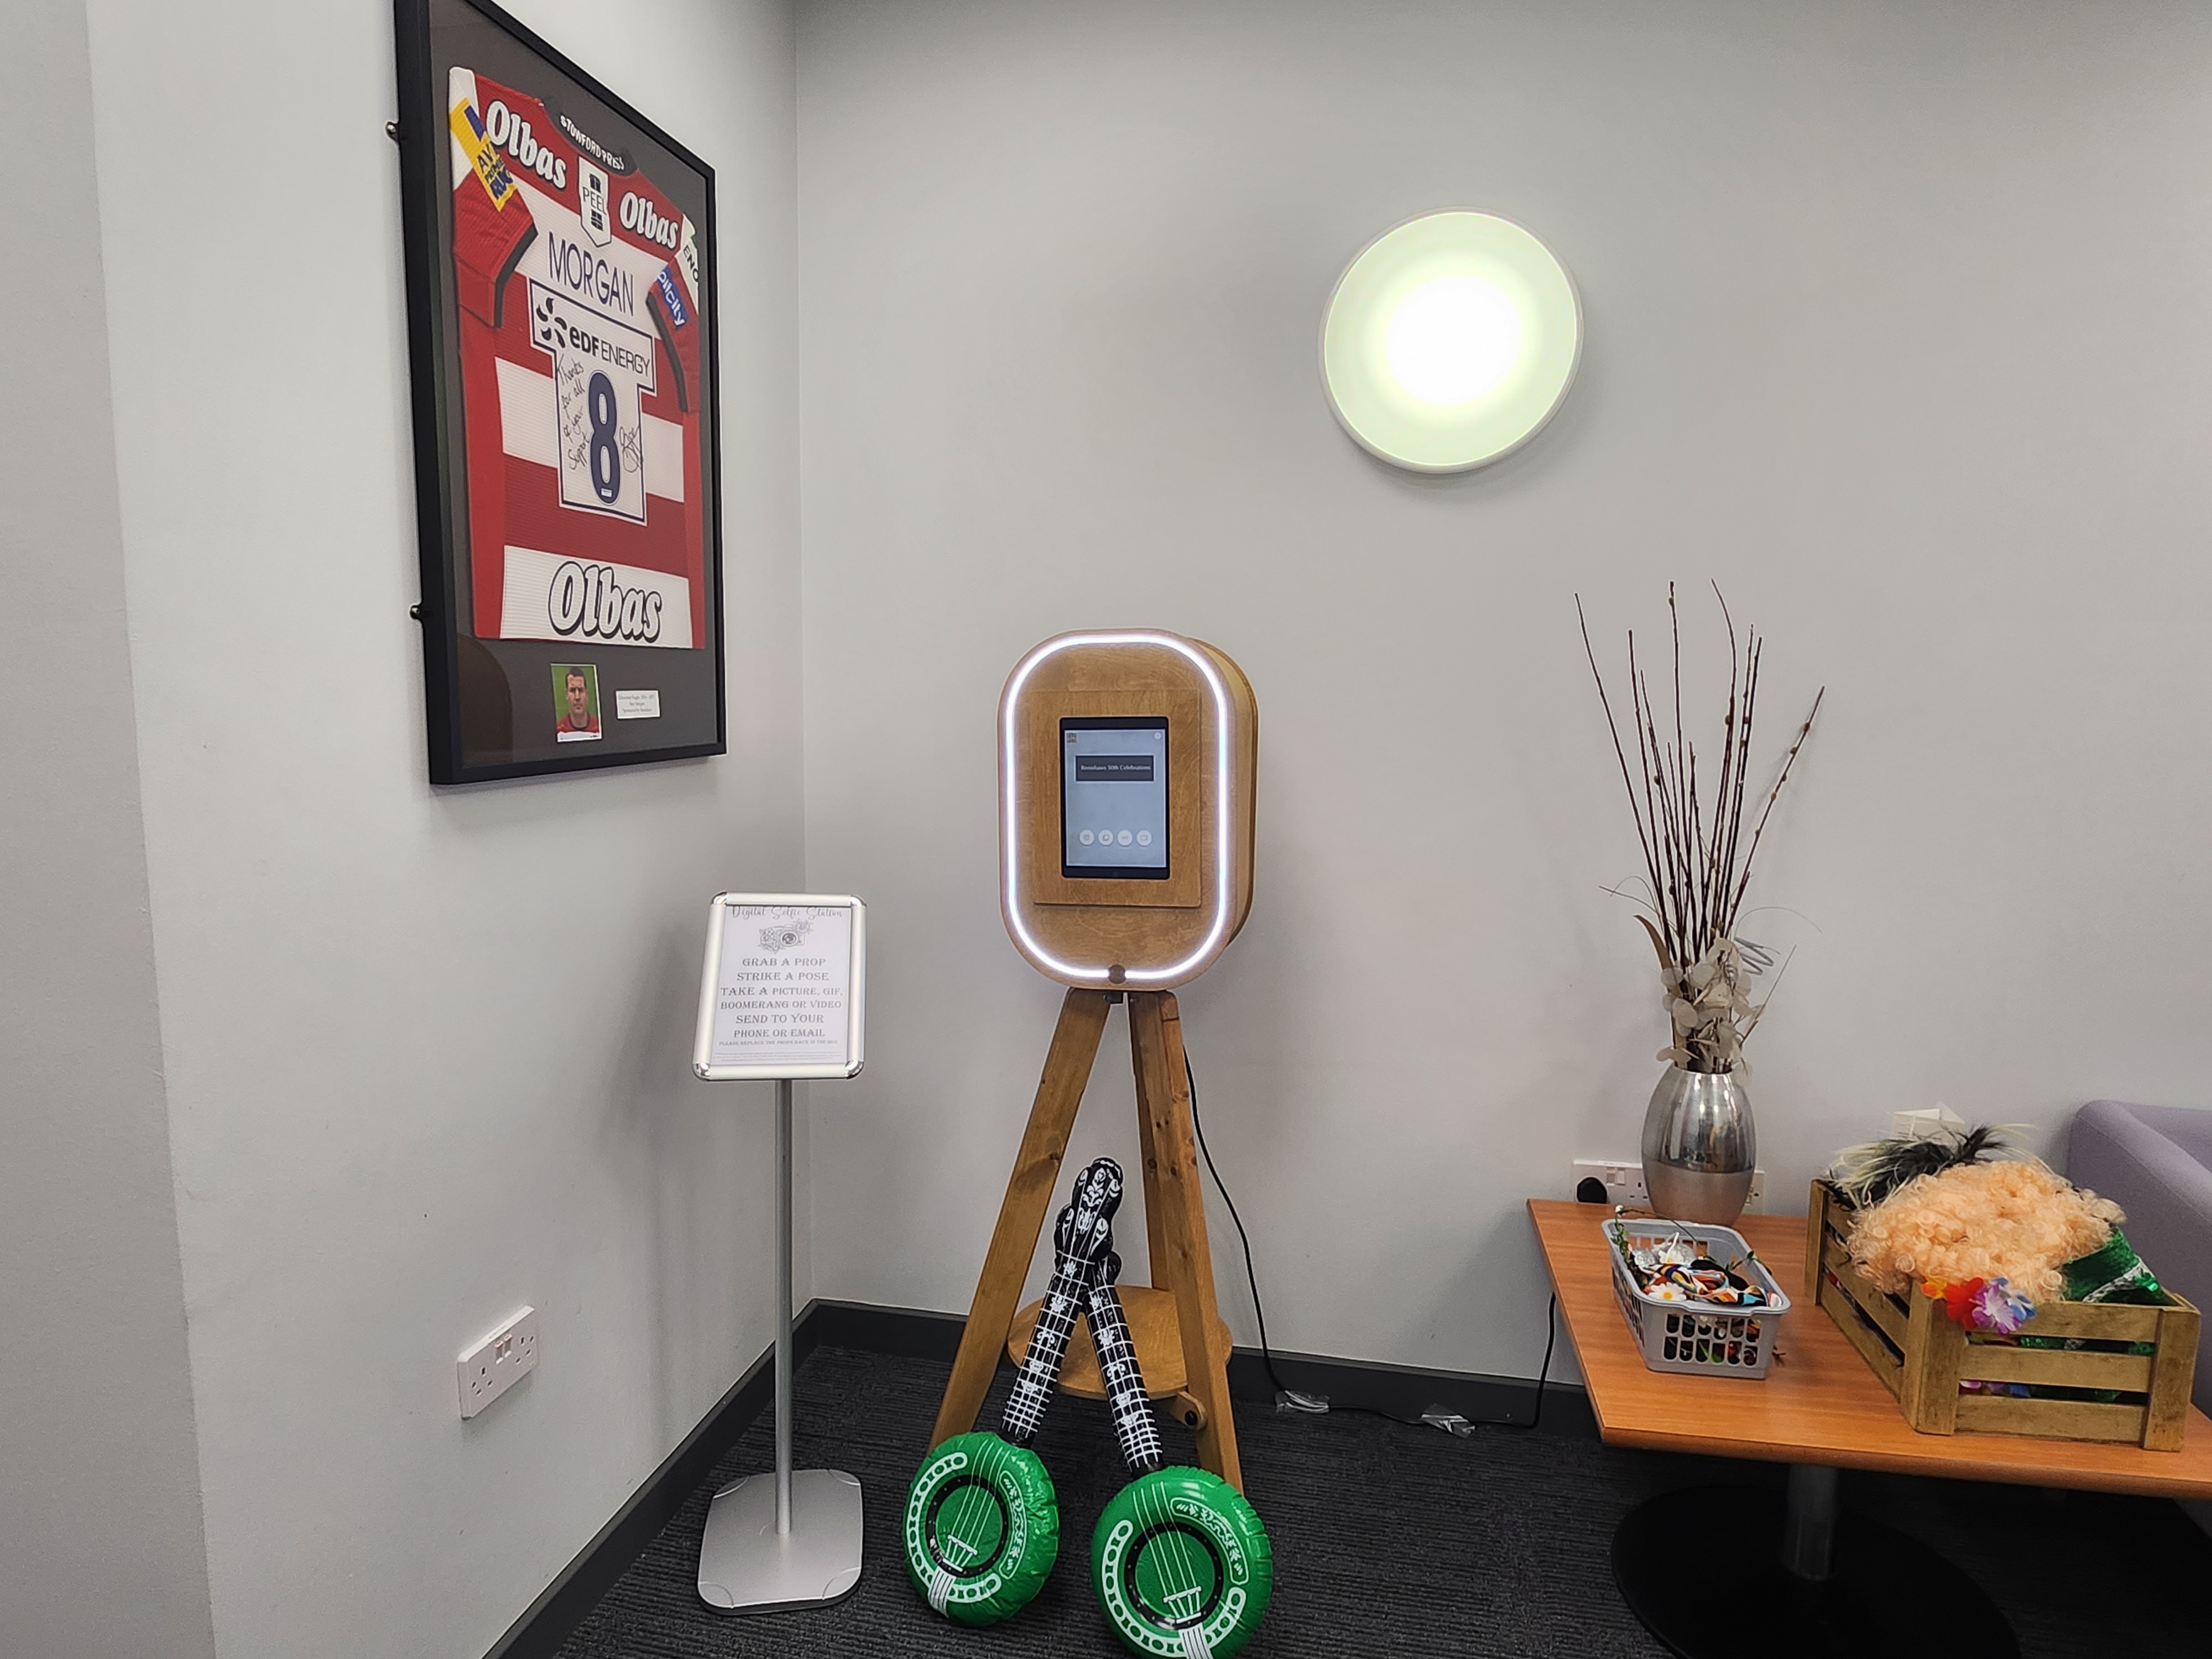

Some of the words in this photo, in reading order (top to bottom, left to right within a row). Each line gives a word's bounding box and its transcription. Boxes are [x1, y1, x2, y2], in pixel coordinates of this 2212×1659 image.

[486, 99, 567, 190] Olbas
[560, 115, 601, 158] STOWFORD
[582, 186, 607, 216] PEEL
[619, 191, 679, 250] Olbas
[549, 231, 634, 317] MORGAN
[587, 369, 621, 505] 8
[549, 560, 662, 643] Olbas
[732, 906, 766, 920] Digital
[771, 906, 801, 920] Selfie
[806, 907, 844, 920] Station
[742, 958, 778, 967] GRAB
[781, 958, 790, 967] A
[794, 958, 826, 966] PROP
[737, 972, 781, 981] STRIKE
[785, 972, 794, 980] A
[798, 972, 829, 980] POSE
[721, 987, 755, 996] TAKE
[759, 987, 768, 995] A
[772, 987, 820, 996] PICTURE,
[822, 987, 843, 996] GIF,
[720, 1000, 789, 1010] BOOMERANG
[792, 1000, 807, 1009] OR
[810, 1000, 842, 1008] VIDEO
[735, 1015, 768, 1024] SEND
[771, 1014, 787, 1023] TO
[790, 1013, 825, 1023] YOUR
[733, 1029, 770, 1039] PHONE
[773, 1029, 787, 1037] OR
[790, 1028, 826, 1037] EMAIL
